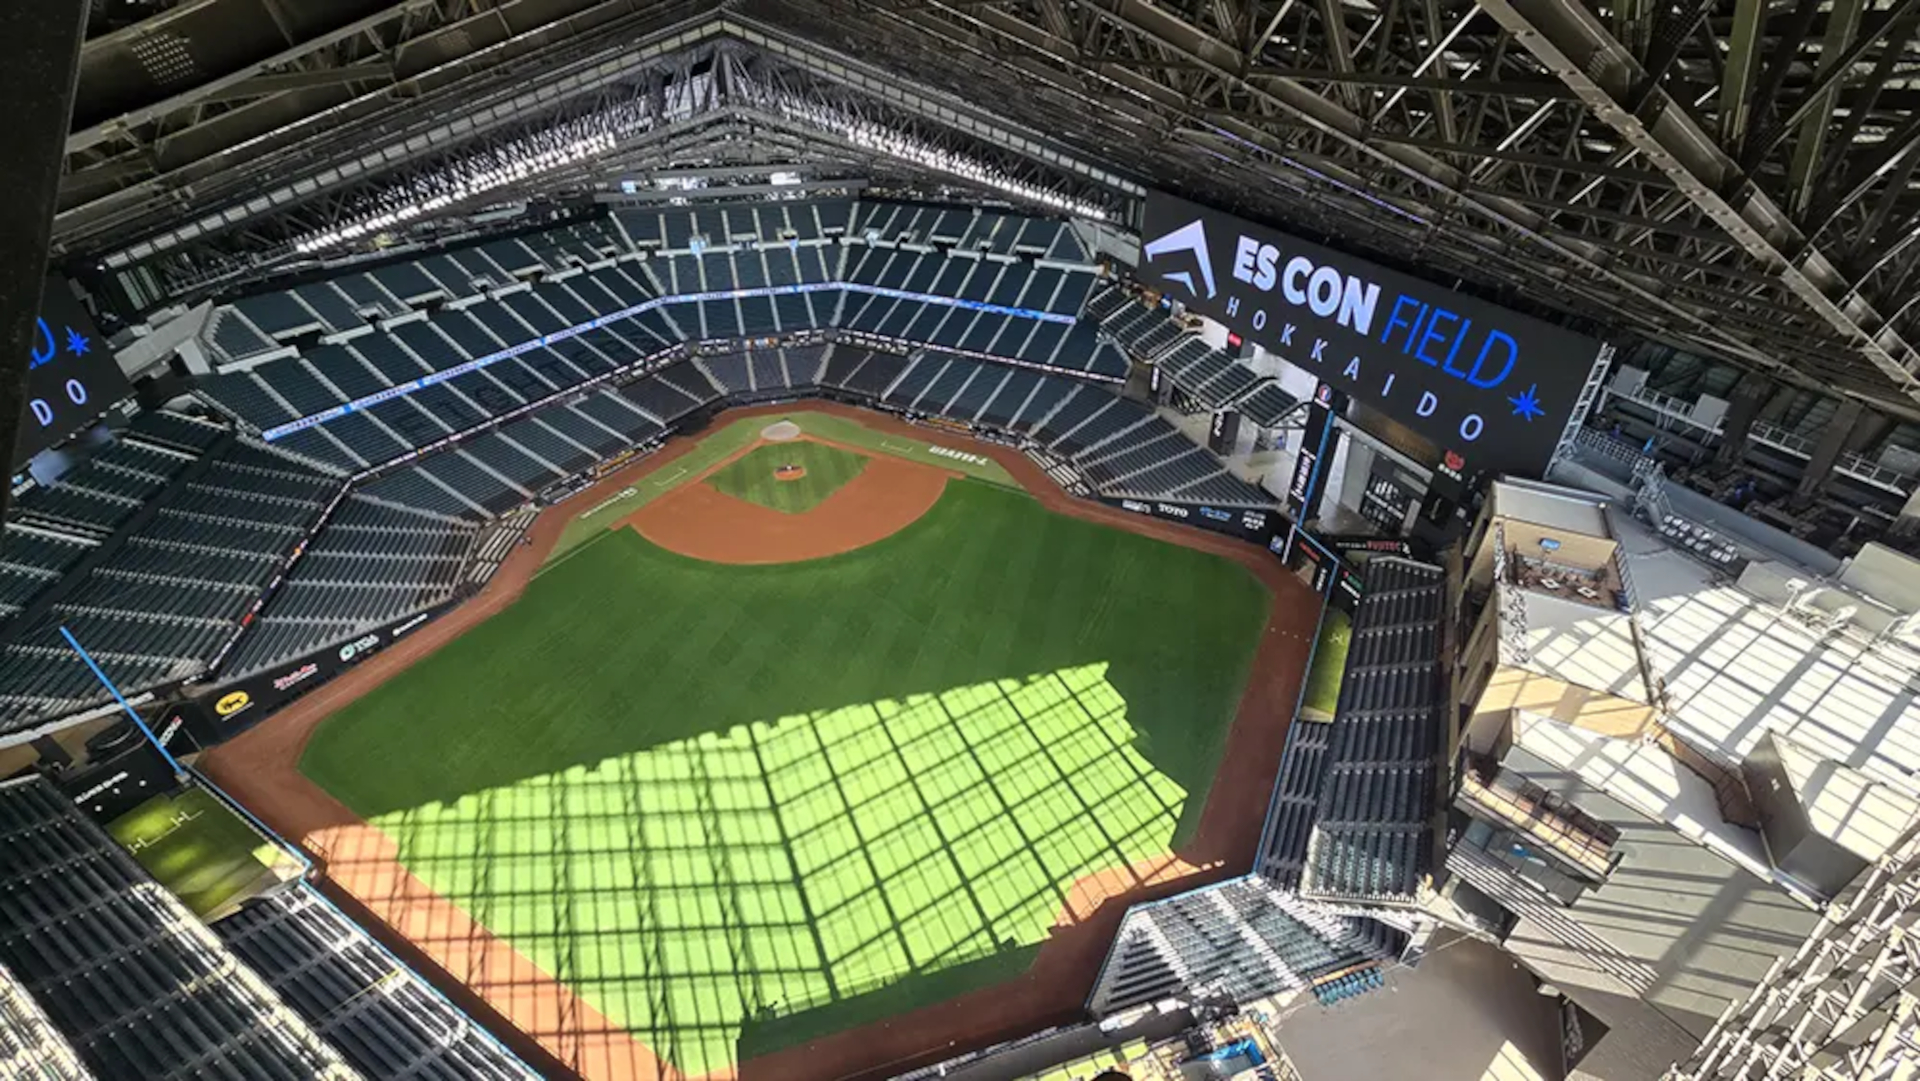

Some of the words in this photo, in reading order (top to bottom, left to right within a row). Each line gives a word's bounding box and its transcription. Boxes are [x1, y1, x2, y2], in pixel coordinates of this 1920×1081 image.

[1226, 296, 1484, 442] HOKKAIDO
[1380, 294, 1519, 390] FIELD
[1157, 501, 1189, 519] TOTO
